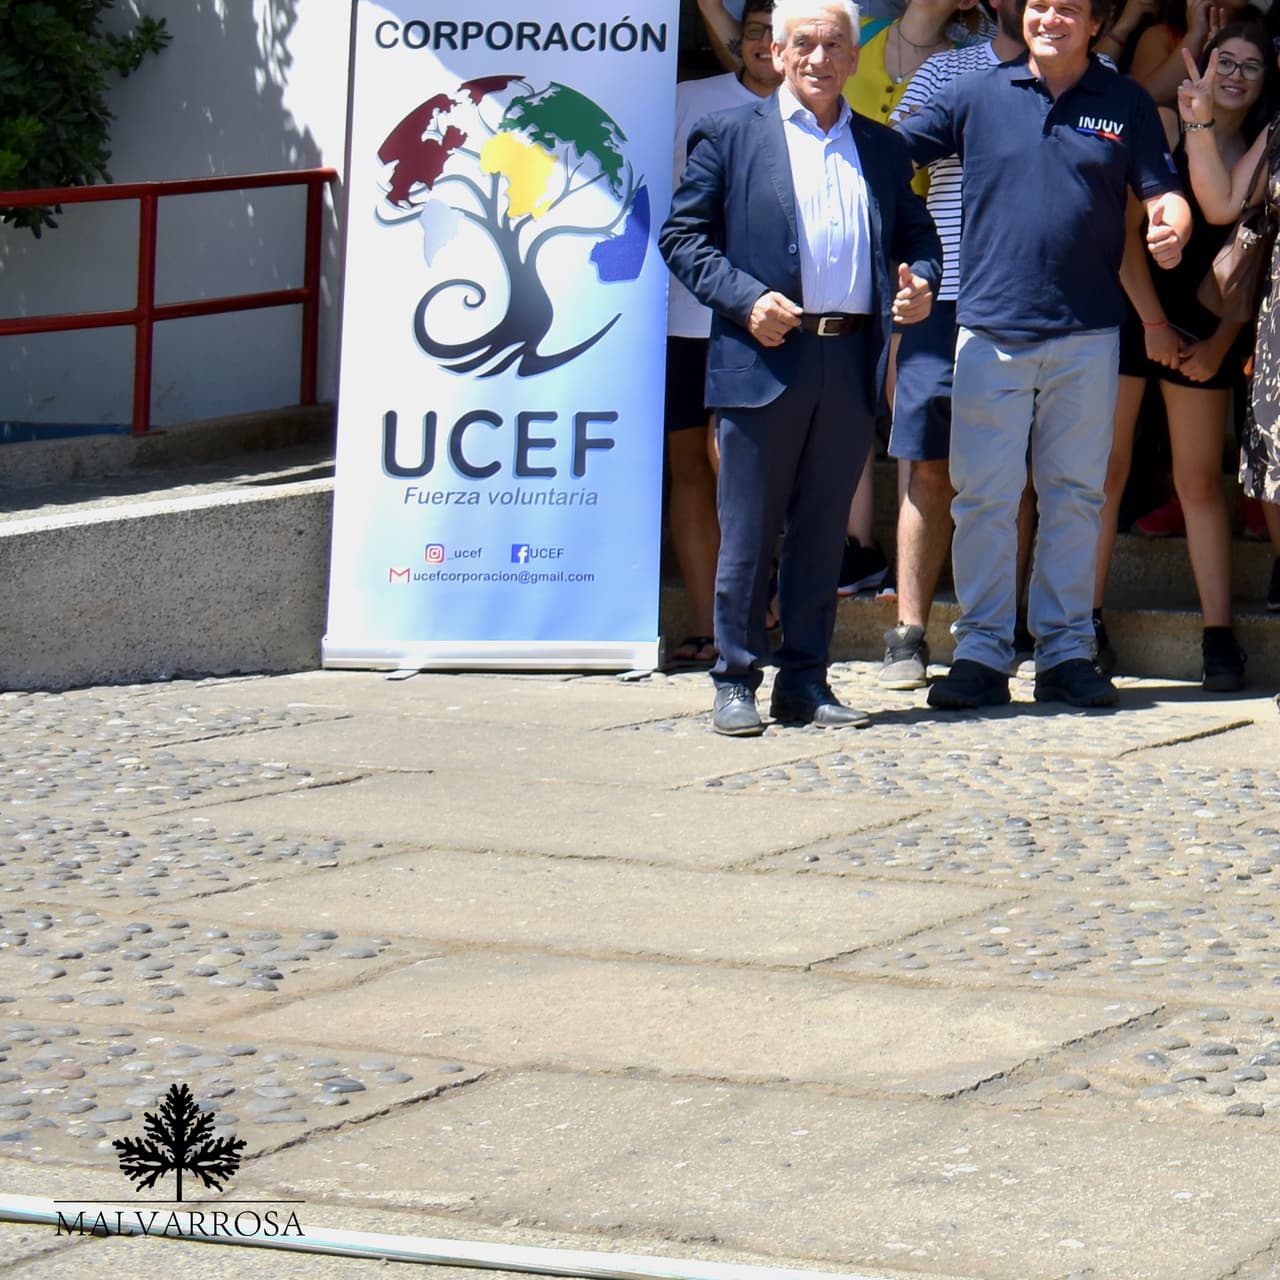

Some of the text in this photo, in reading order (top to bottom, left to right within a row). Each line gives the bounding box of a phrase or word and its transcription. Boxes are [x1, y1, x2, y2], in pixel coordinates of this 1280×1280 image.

[375, 16, 667, 53] CORPORACIÓN
[1078, 116, 1124, 135] INJUV
[382, 410, 618, 480] UCEF
[403, 486, 598, 506] Fuerza voluntaria
[530, 548, 564, 559] UCEF
[413, 569, 595, 584] ucefcorporacion@gmail.com
